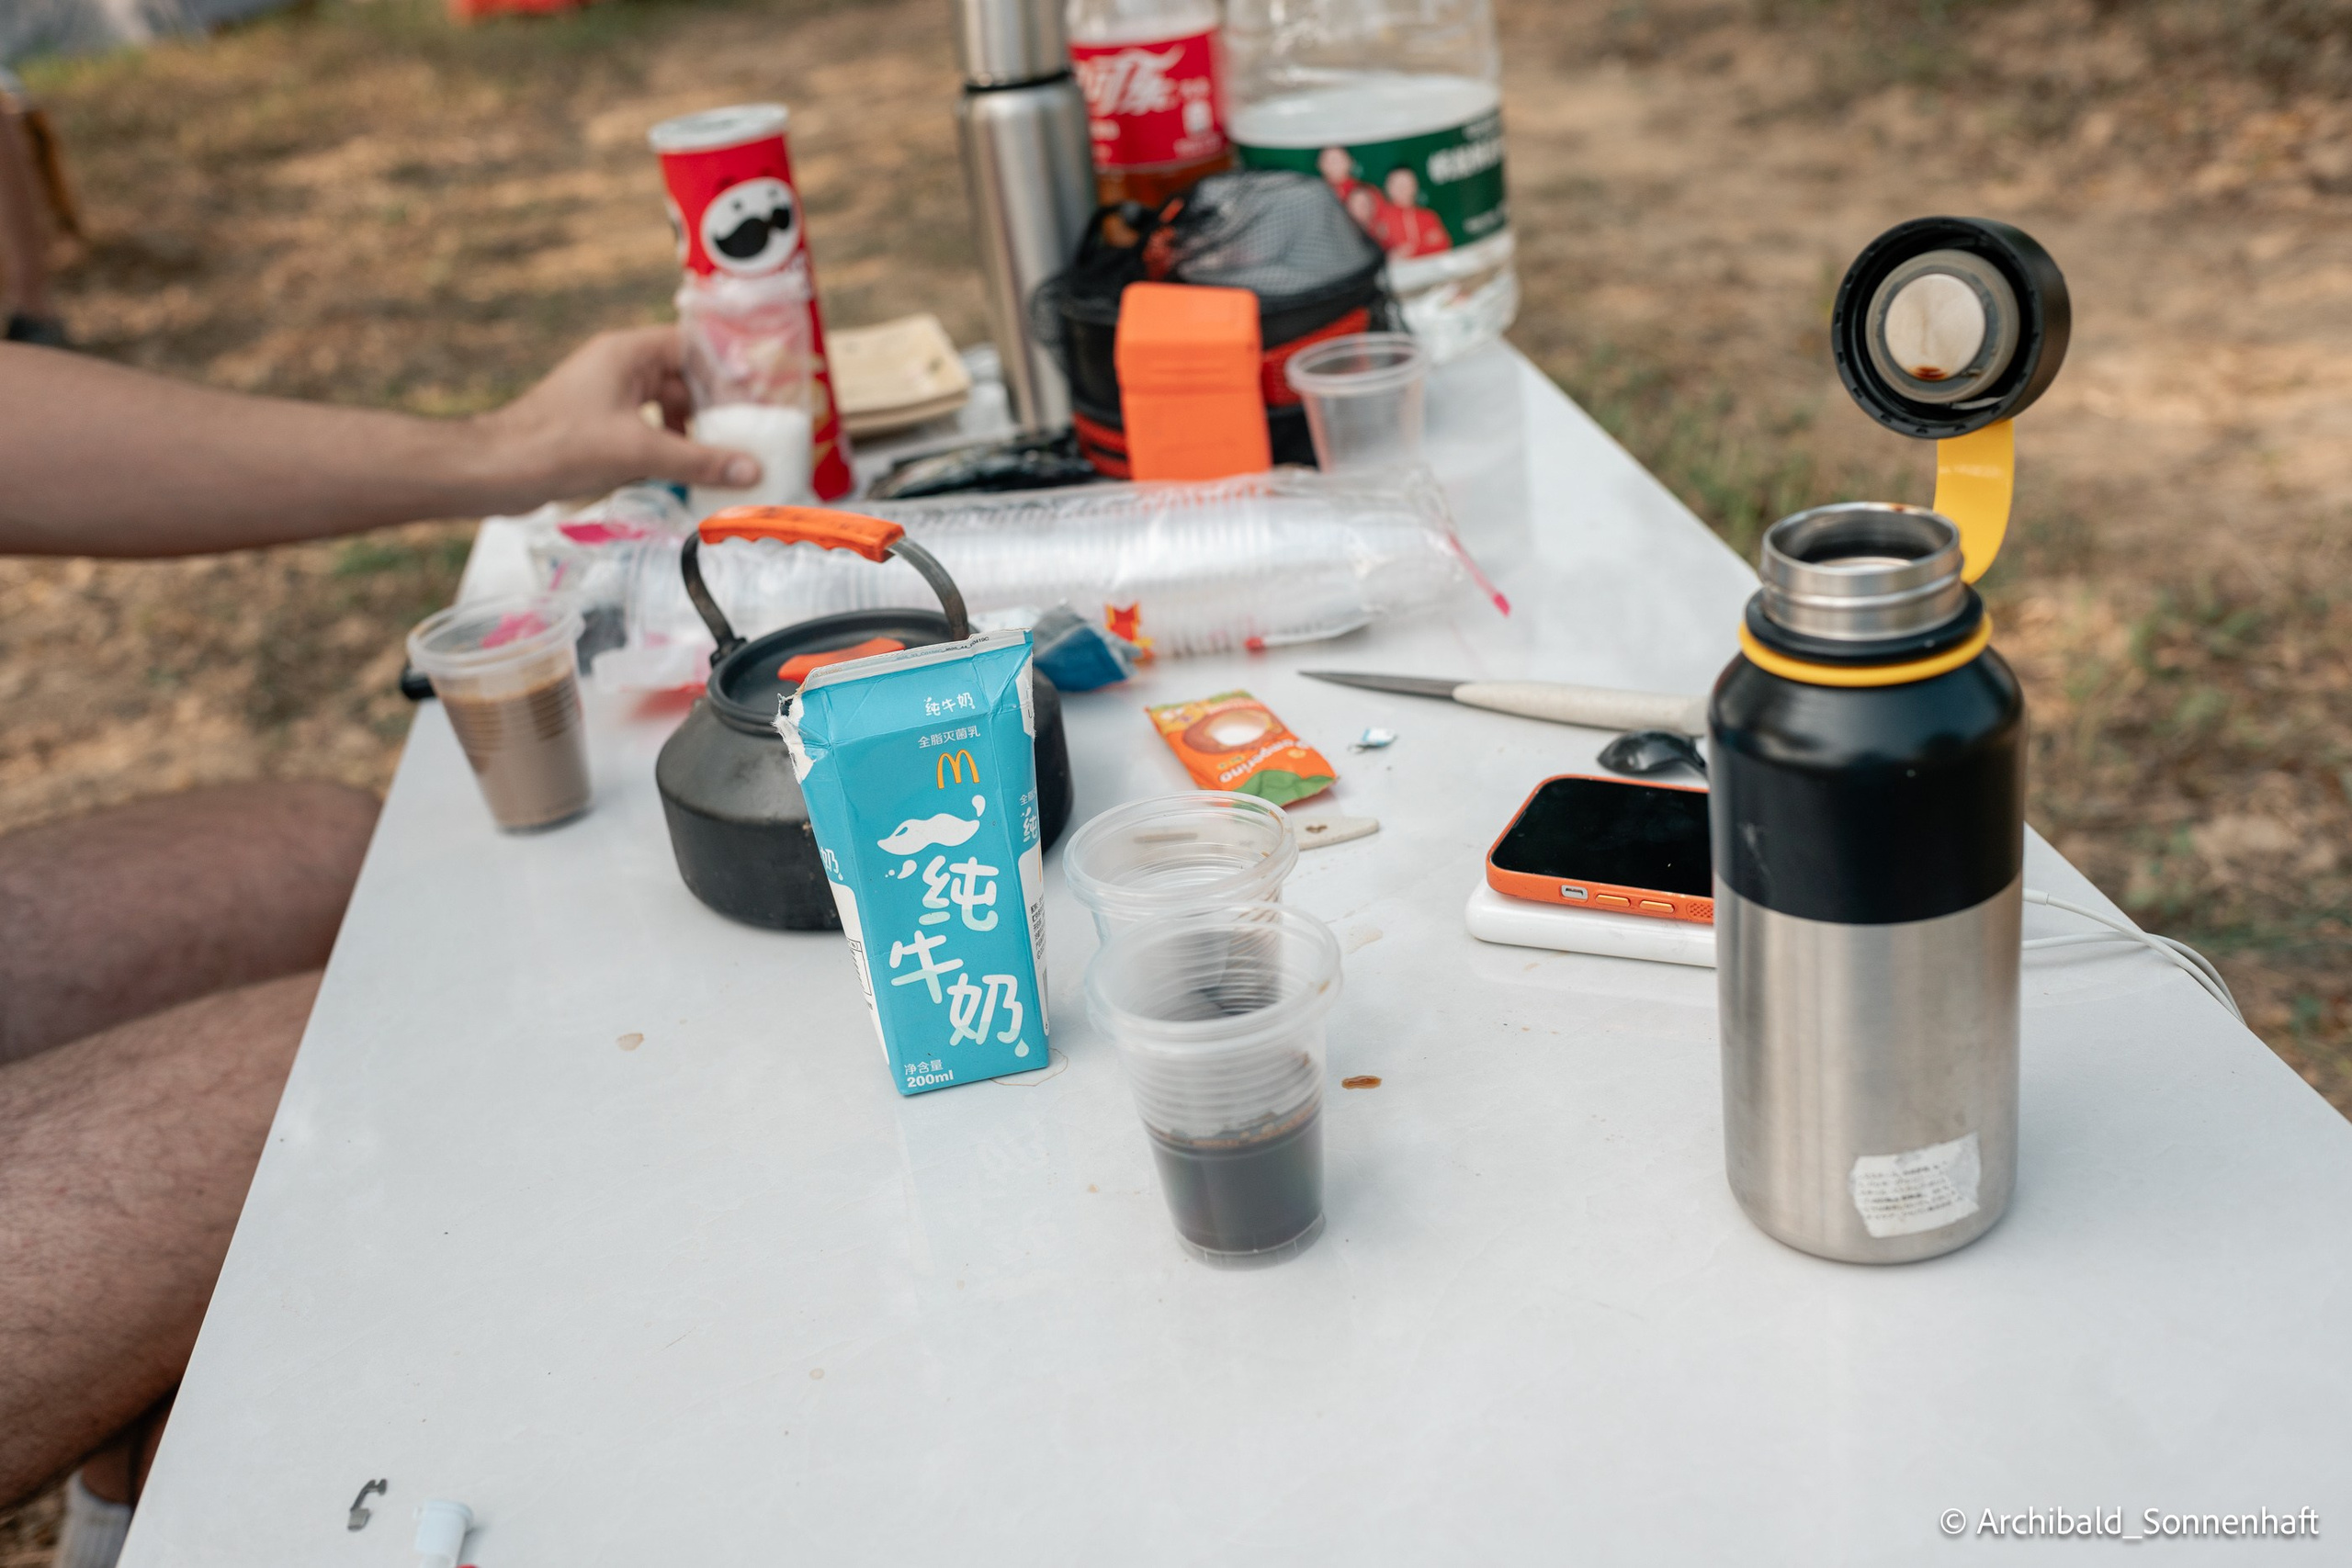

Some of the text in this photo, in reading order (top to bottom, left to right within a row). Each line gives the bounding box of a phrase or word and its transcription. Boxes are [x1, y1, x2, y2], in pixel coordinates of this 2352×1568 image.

[924, 693, 976, 716] 纯牛奶
[919, 725, 981, 749] 全脂灭菌乳
[904, 1059, 944, 1076] 净含量
[907, 1069, 955, 1089] 200ml
